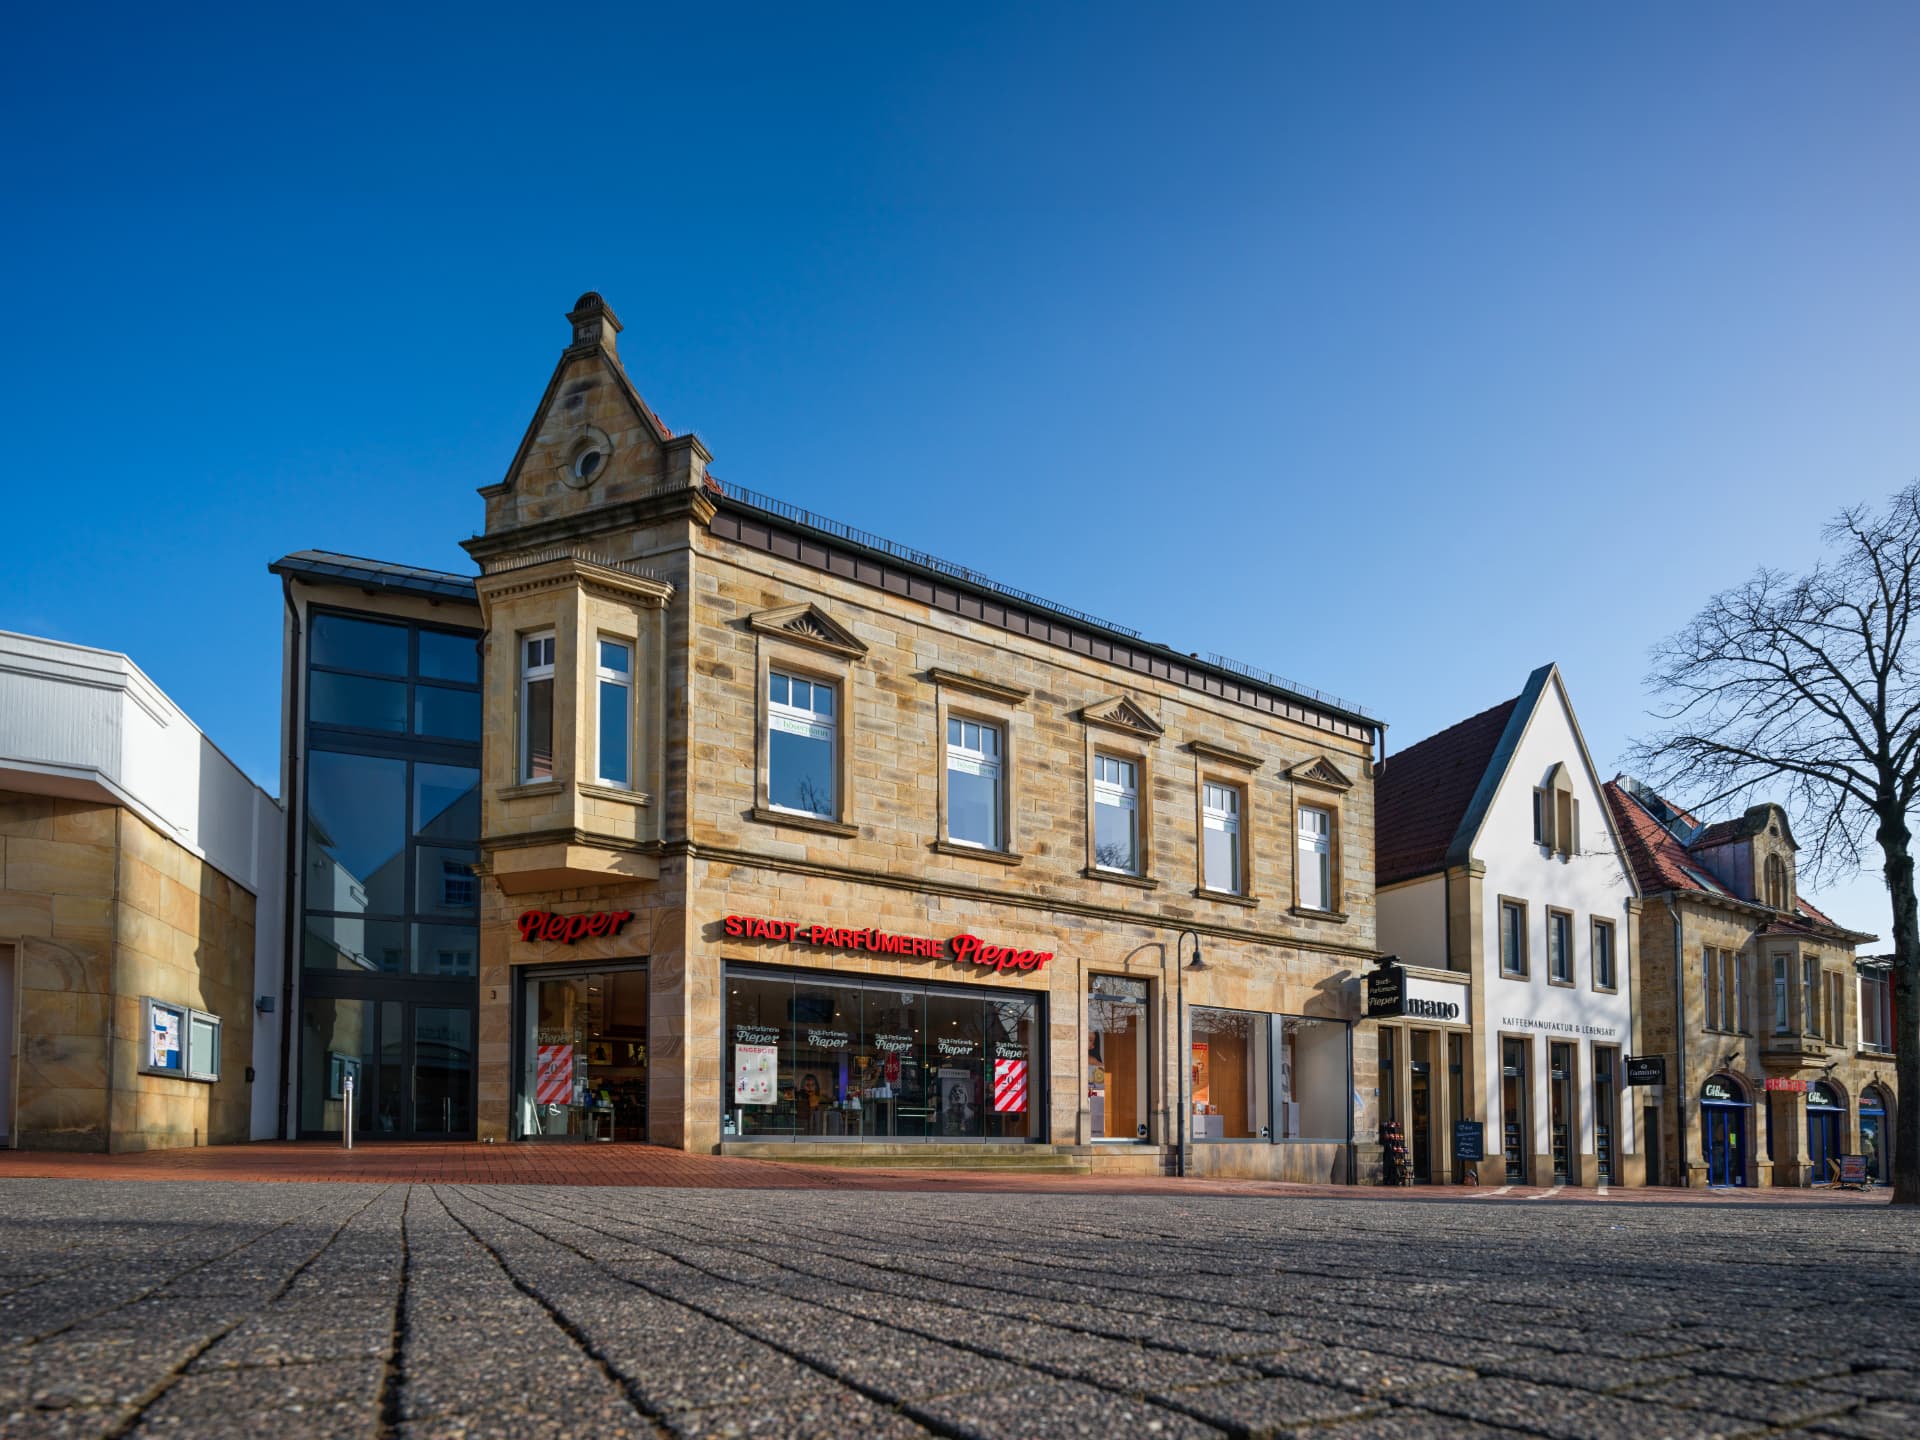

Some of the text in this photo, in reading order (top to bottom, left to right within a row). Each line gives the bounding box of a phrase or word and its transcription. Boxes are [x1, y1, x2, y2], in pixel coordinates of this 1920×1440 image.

[517, 909, 632, 945] Pieper
[725, 915, 1054, 972] STADT-PARFÜMERIE Pieper
[1368, 996, 1400, 1007] Pieper
[1408, 998, 1460, 1019] mano
[1502, 1016, 1574, 1032] KAFFEEMANUFAKTUR
[1581, 1025, 1617, 1037] LEBENSART
[736, 1030, 780, 1045] Pieper
[807, 1034, 849, 1049] Pieper
[875, 1039, 913, 1052] Pieper
[937, 1043, 974, 1056] Pieper
